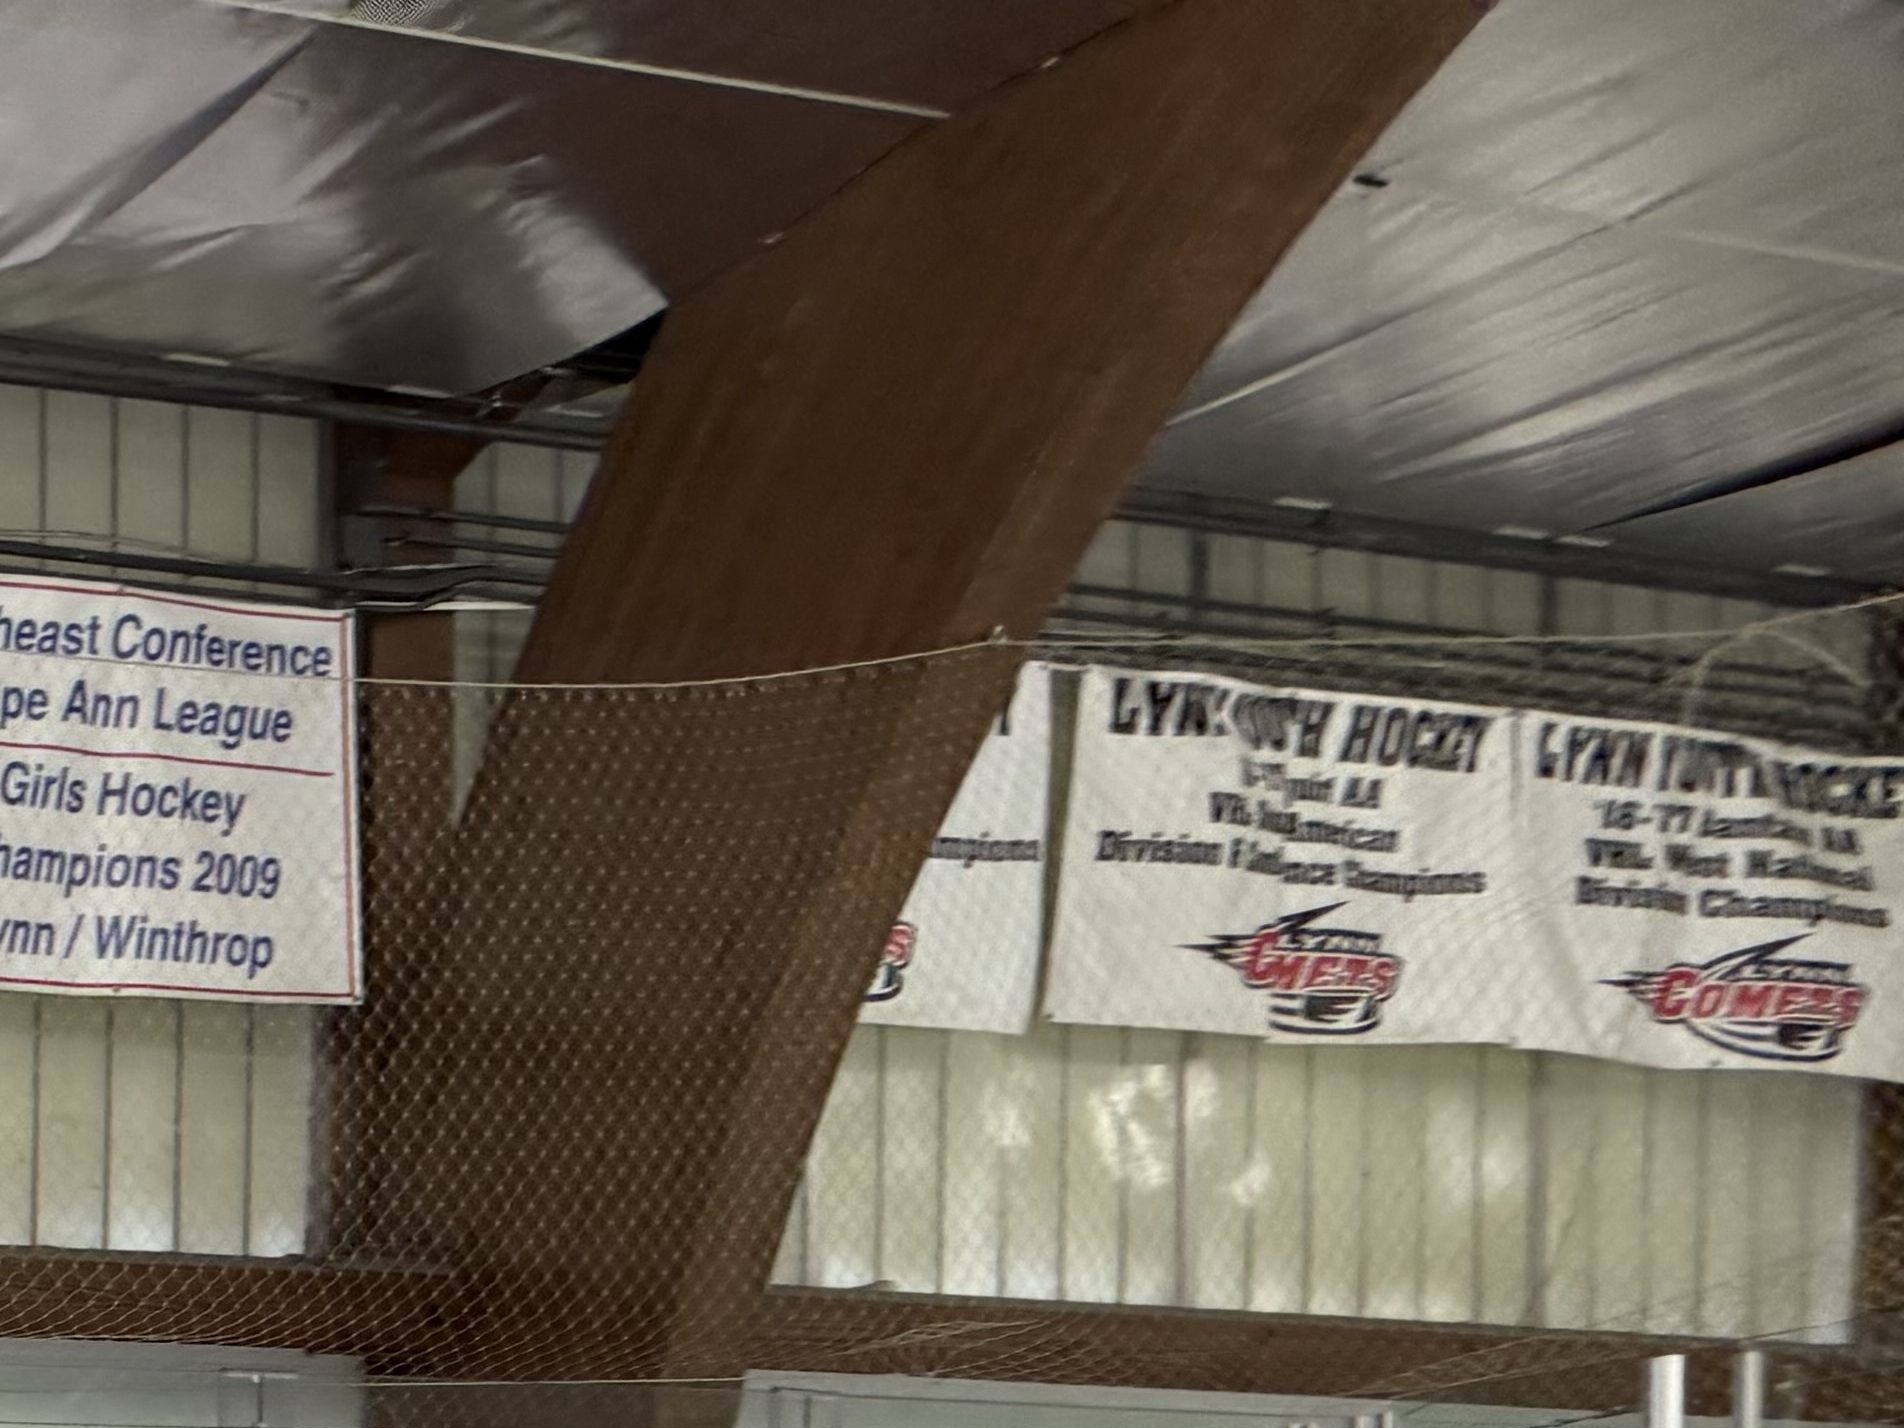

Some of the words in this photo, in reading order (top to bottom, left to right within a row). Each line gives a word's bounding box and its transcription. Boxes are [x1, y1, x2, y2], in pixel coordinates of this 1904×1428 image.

[113, 612, 333, 679] Conference
[61, 677, 140, 730] Ann
[153, 689, 294, 747] League
[0, 761, 86, 813] Girls
[97, 771, 247, 835] Hockey
[192, 848, 281, 901] 2009
[96, 913, 275, 979] Winthrop
